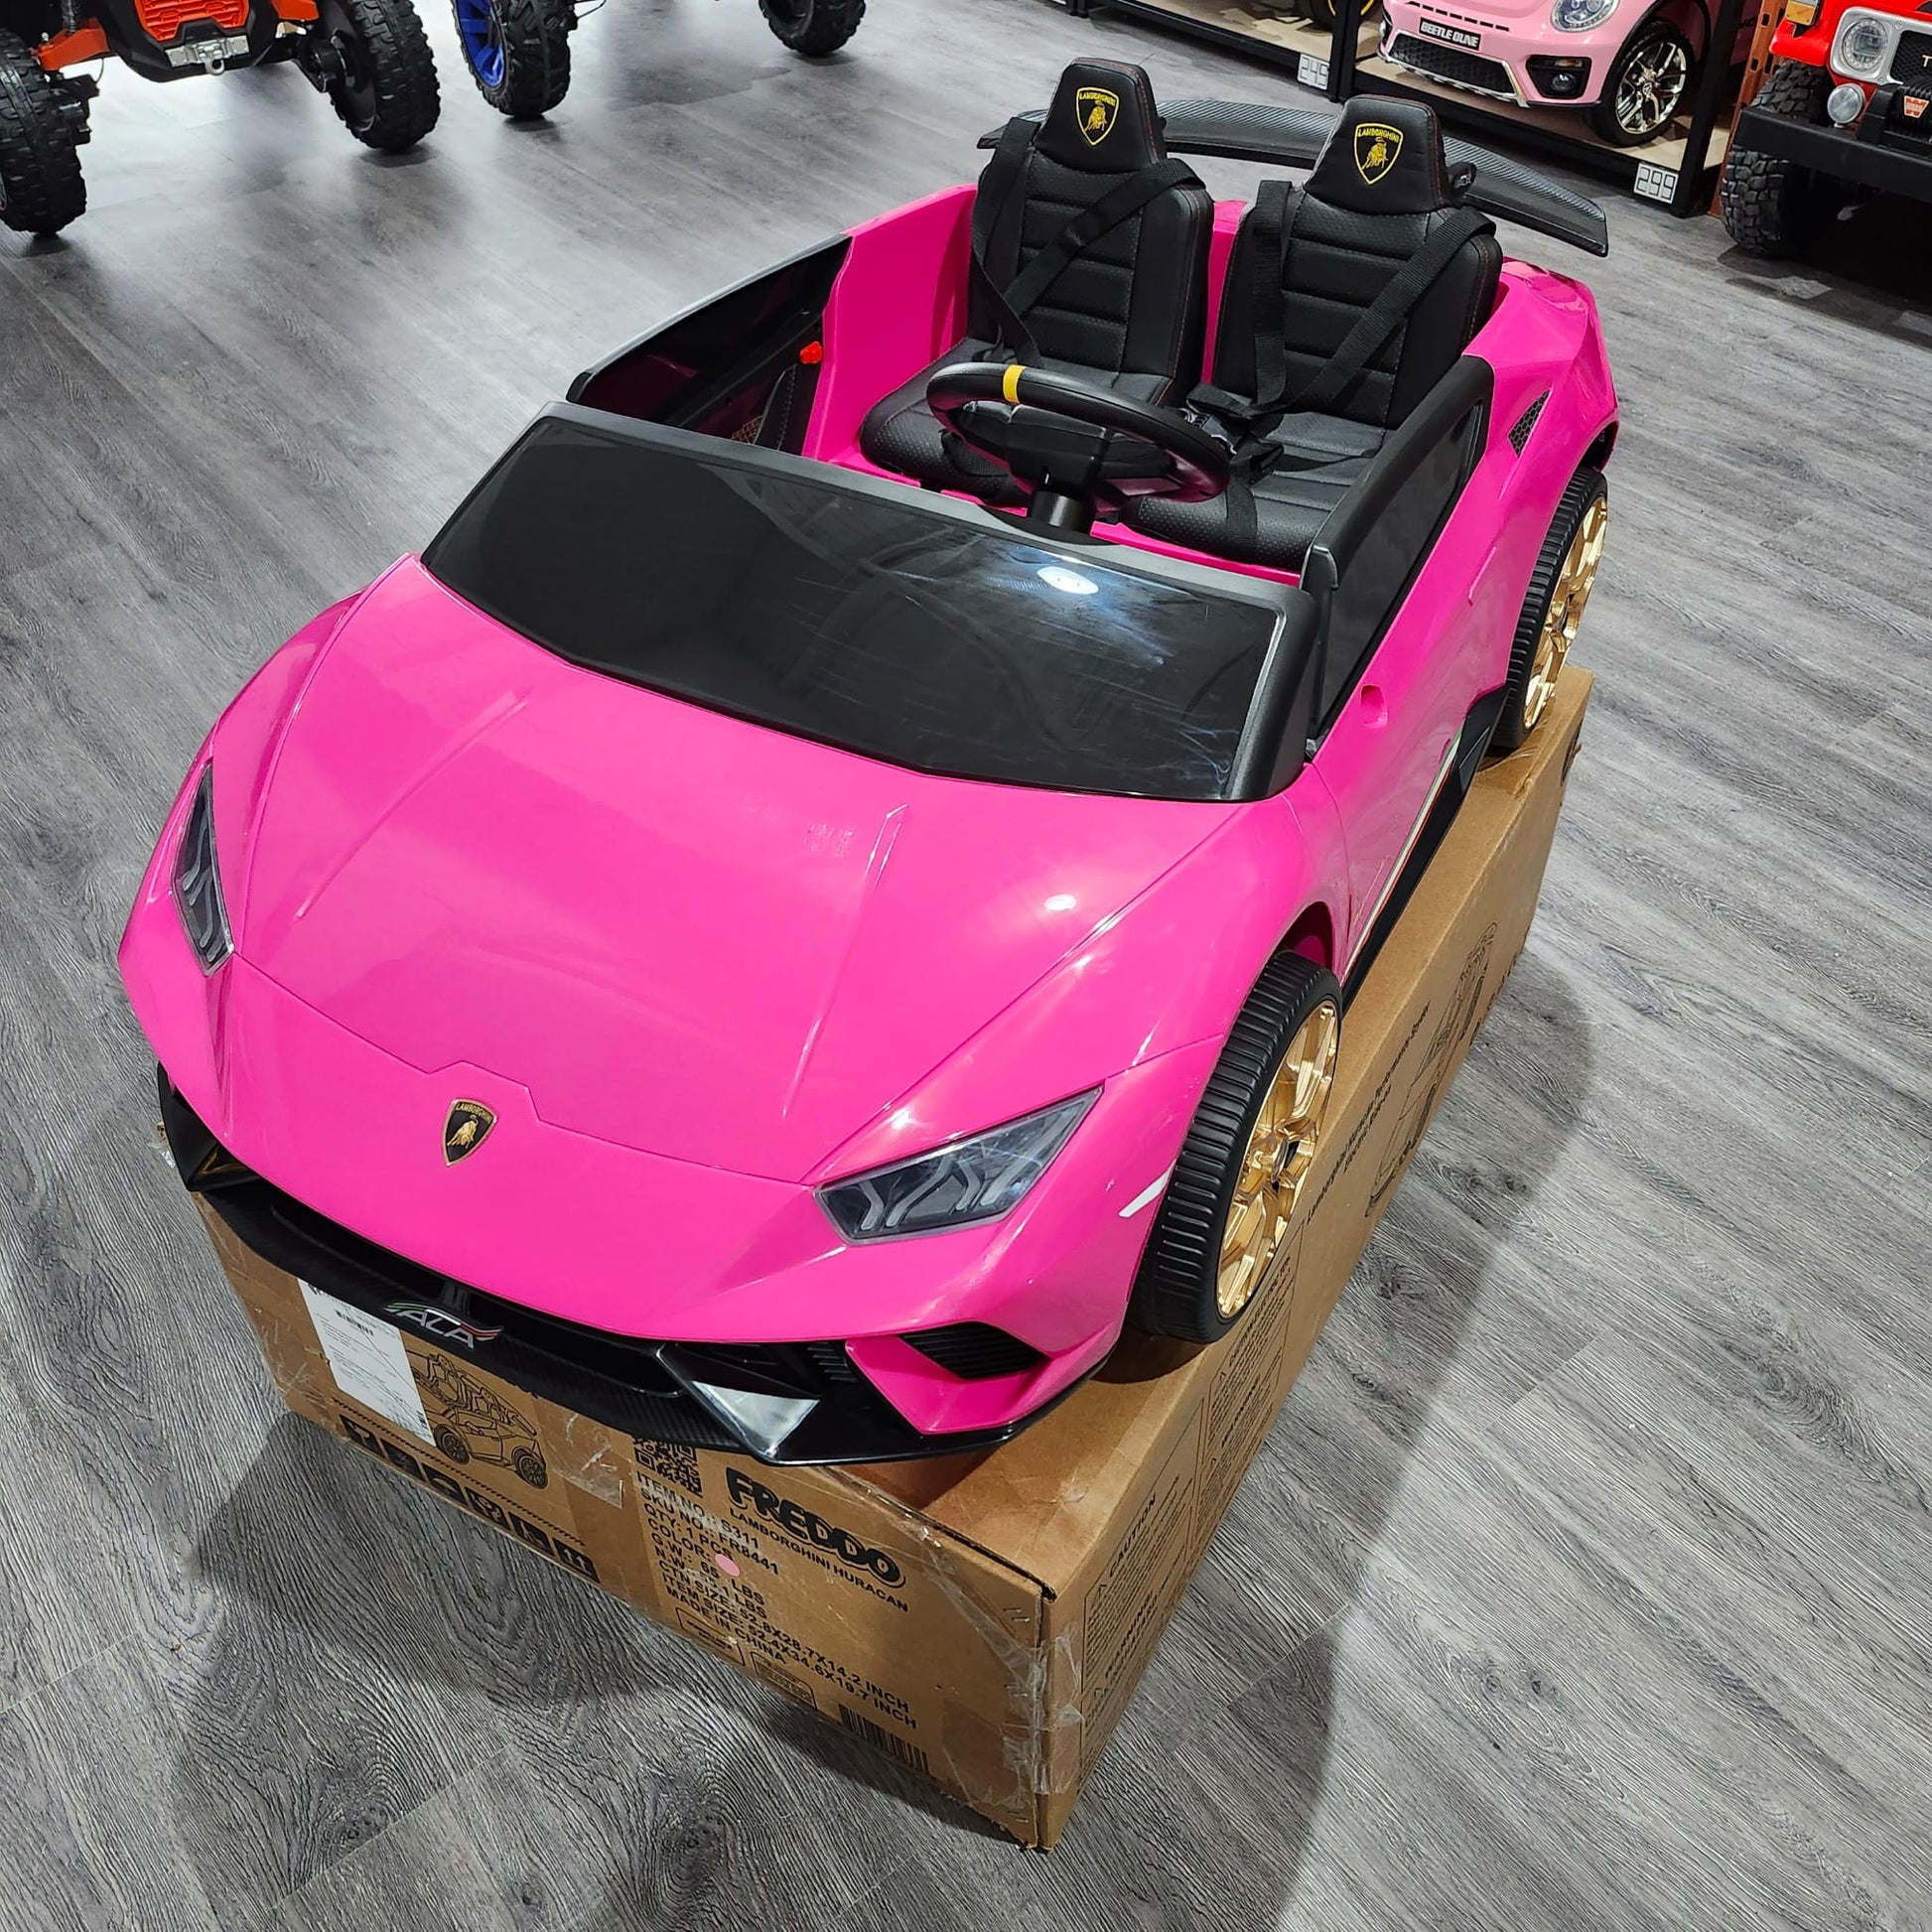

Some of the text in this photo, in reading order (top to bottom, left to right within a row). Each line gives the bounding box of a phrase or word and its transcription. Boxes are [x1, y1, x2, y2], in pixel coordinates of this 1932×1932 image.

[1421, 21, 1453, 40] BEETLE
[1636, 166, 1676, 201] 299
[636, 1470, 677, 1502] ITEM
[720, 1519, 759, 1549] S311
[641, 1488, 675, 1514] SKU
[719, 1533, 779, 1576] FR8441
[643, 1503, 681, 1532] QTY:
[699, 1534, 733, 1561] PCS
[648, 1518, 711, 1562] COLOR:
[726, 1466, 905, 1588] FREDDO
[1109, 1493, 1157, 1578] CAUTION
[700, 1561, 720, 1580] 65
[732, 1579, 764, 1606] LBS
[730, 1507, 908, 1613] LAMBORGHINI HURACAN
[659, 1560, 690, 1584] CTN
[696, 1582, 736, 1611] SIZE:
[866, 1681, 909, 1714] INCH
[666, 1587, 712, 1620] MADE
[715, 1616, 732, 1632] IN
[735, 1628, 787, 1665] CHINA
[735, 1593, 767, 1620] LBS
[663, 1573, 699, 1601] ITEM
[707, 1597, 742, 1628] SIZE:
[874, 1698, 917, 1730] INCH
